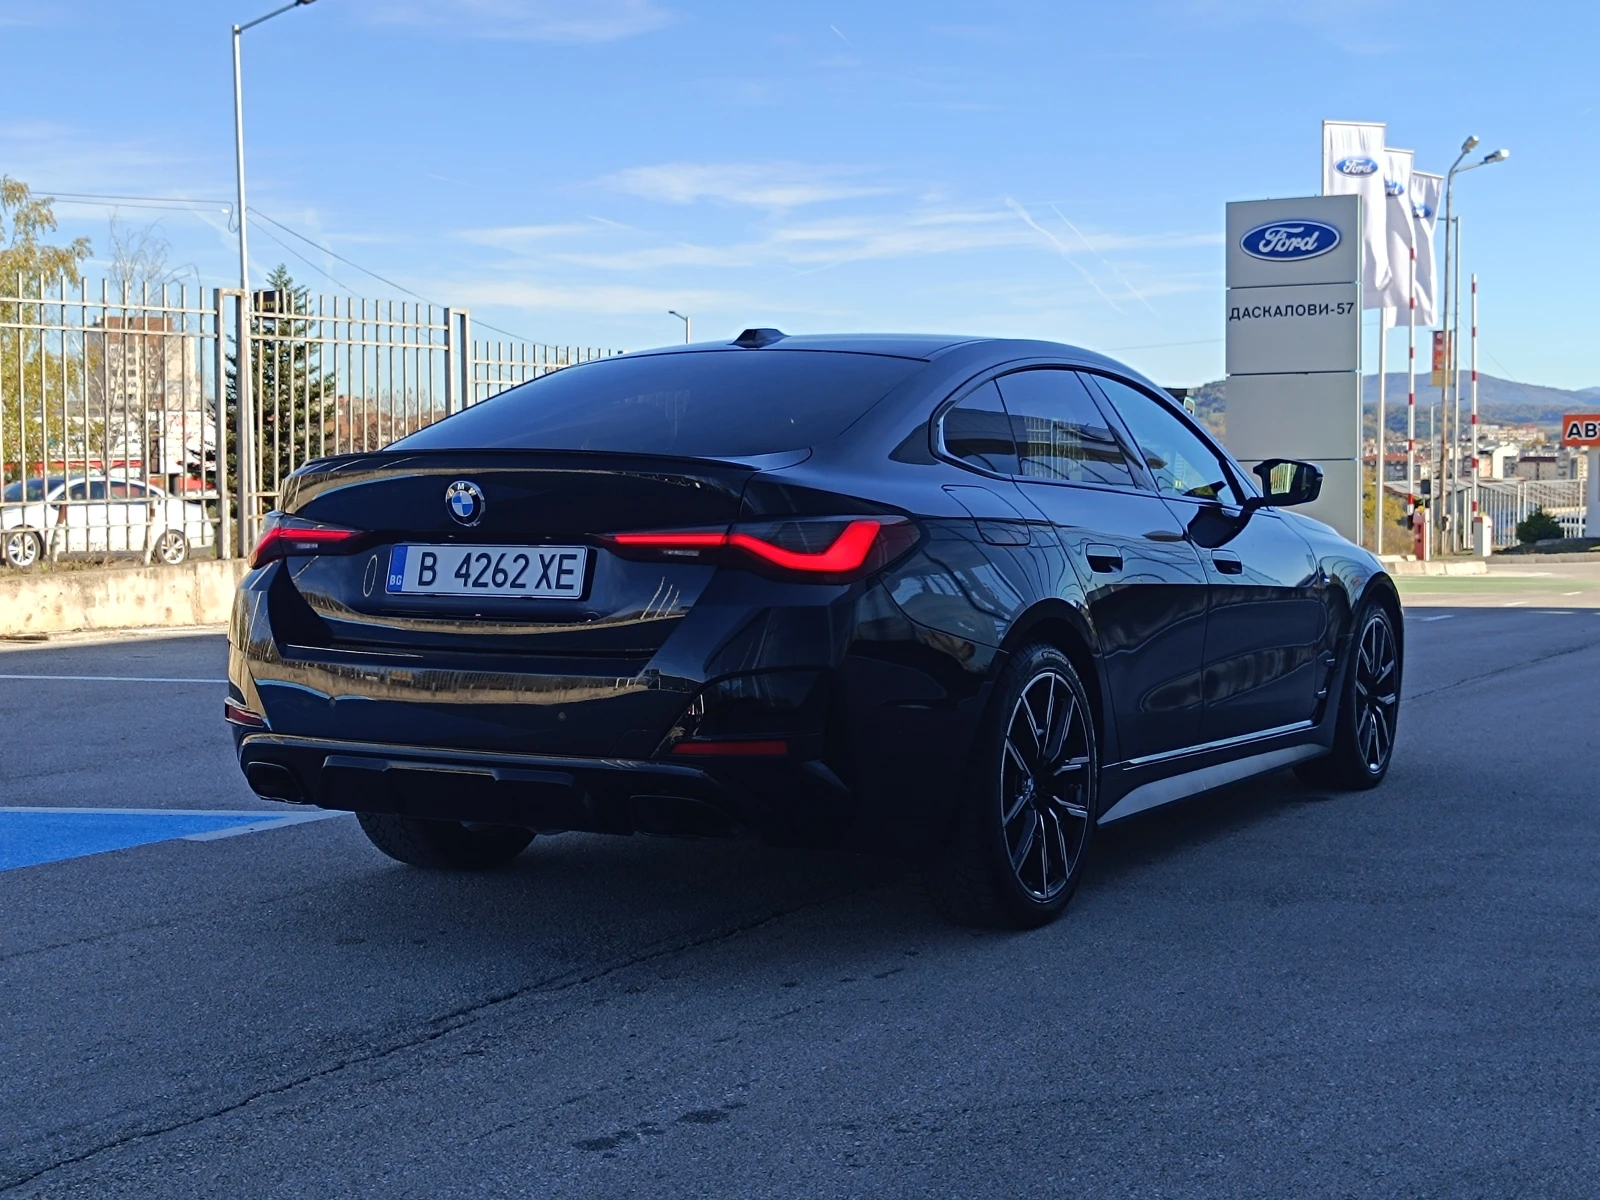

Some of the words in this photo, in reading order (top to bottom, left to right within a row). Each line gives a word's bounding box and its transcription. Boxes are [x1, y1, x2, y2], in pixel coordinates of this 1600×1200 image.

[1343, 159, 1373, 174] Ford
[1258, 226, 1320, 253] Ford
[1229, 302, 1354, 321] ДАСКАЛОВИ-57
[1566, 421, 1600, 439] АВ
[389, 575, 402, 585] BG
[418, 552, 437, 586] B
[454, 552, 529, 589] 4262
[534, 554, 577, 590] XE
